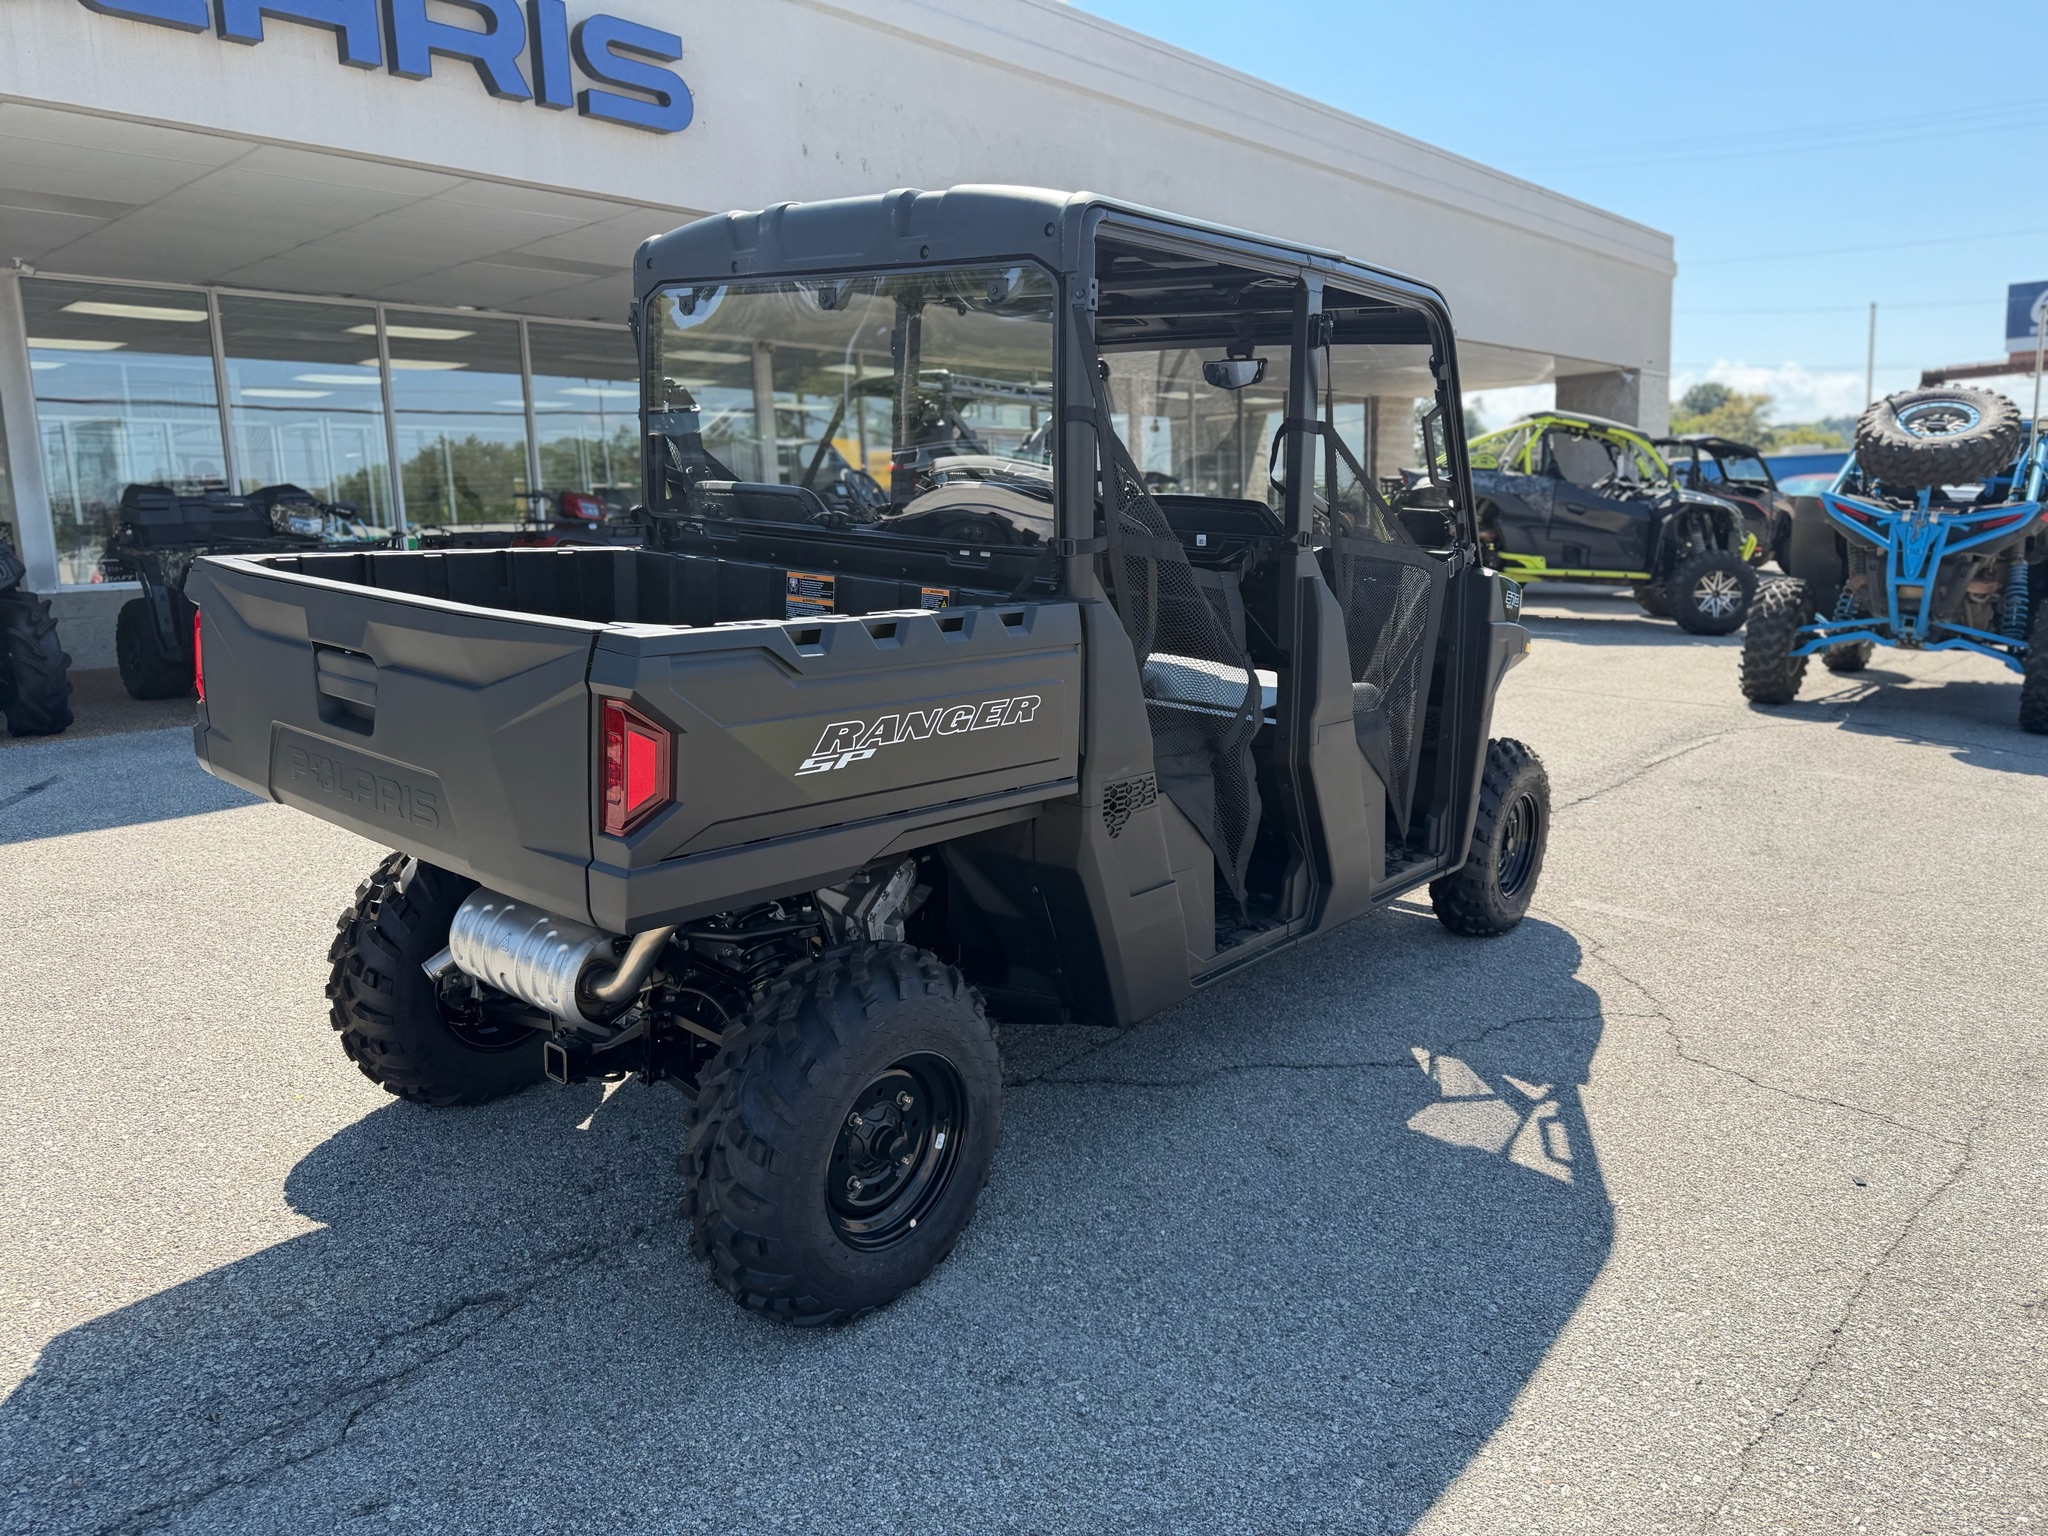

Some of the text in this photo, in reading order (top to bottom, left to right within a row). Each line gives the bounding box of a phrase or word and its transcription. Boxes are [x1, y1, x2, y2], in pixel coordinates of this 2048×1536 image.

[78, 0, 694, 135] ARIS
[794, 748, 877, 776] SP
[811, 694, 1042, 757] RANGER
[287, 744, 440, 831] POLARIS
